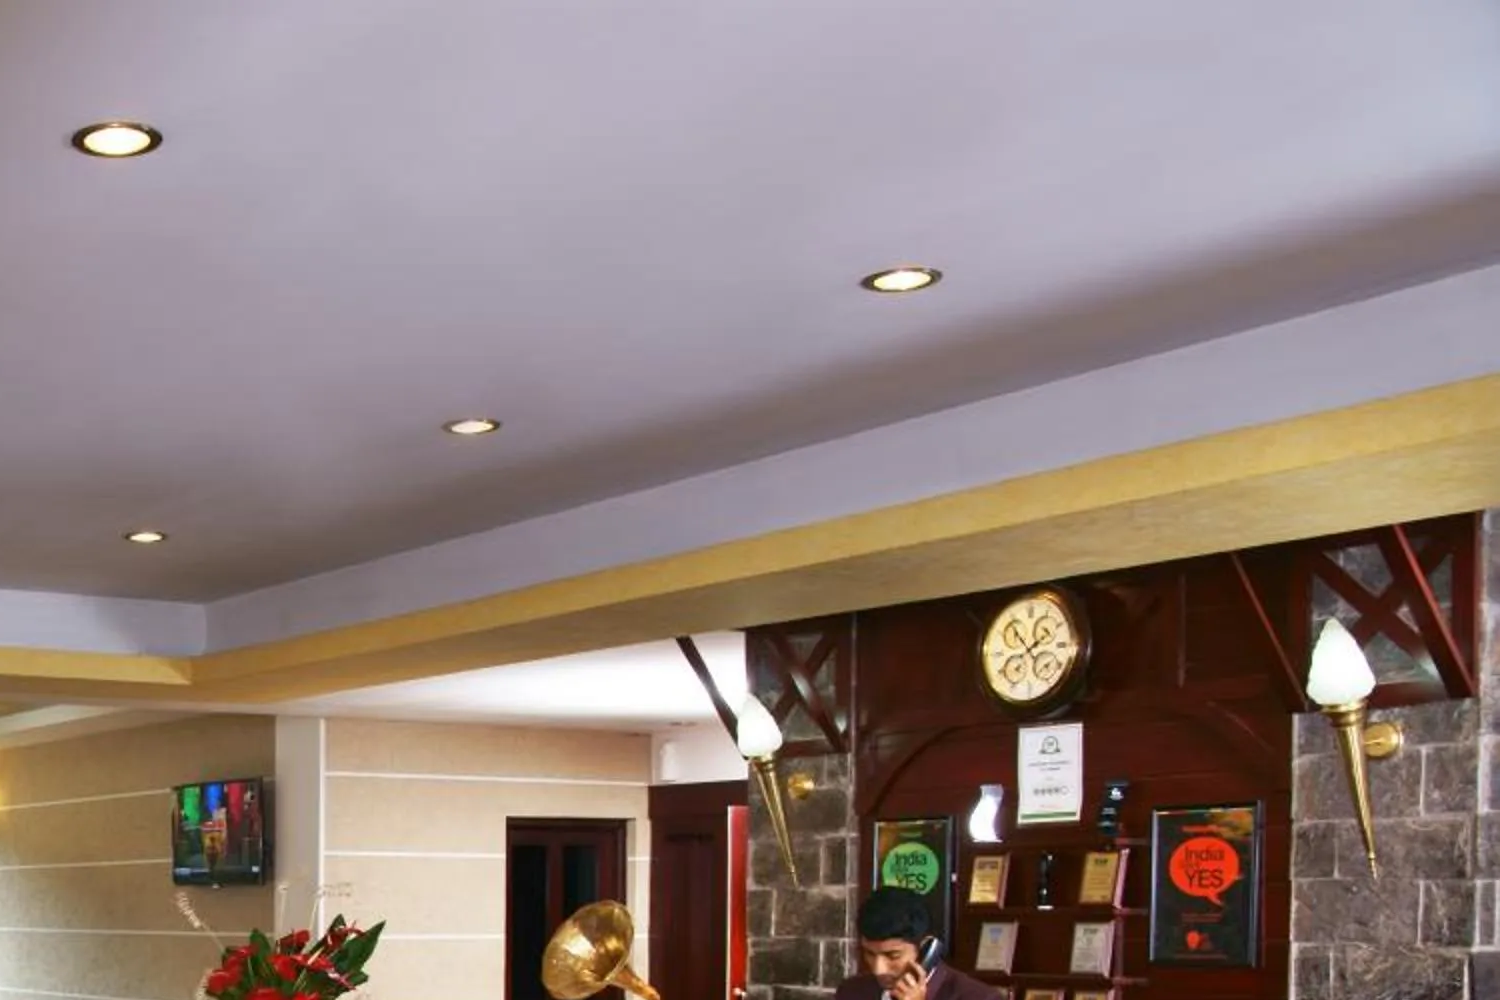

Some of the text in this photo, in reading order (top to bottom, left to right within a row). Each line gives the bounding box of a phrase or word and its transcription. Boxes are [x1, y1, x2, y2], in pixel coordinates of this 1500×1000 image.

[895, 851, 927, 866] India
[1185, 846, 1225, 861] India
[1185, 869, 1224, 889] YES
